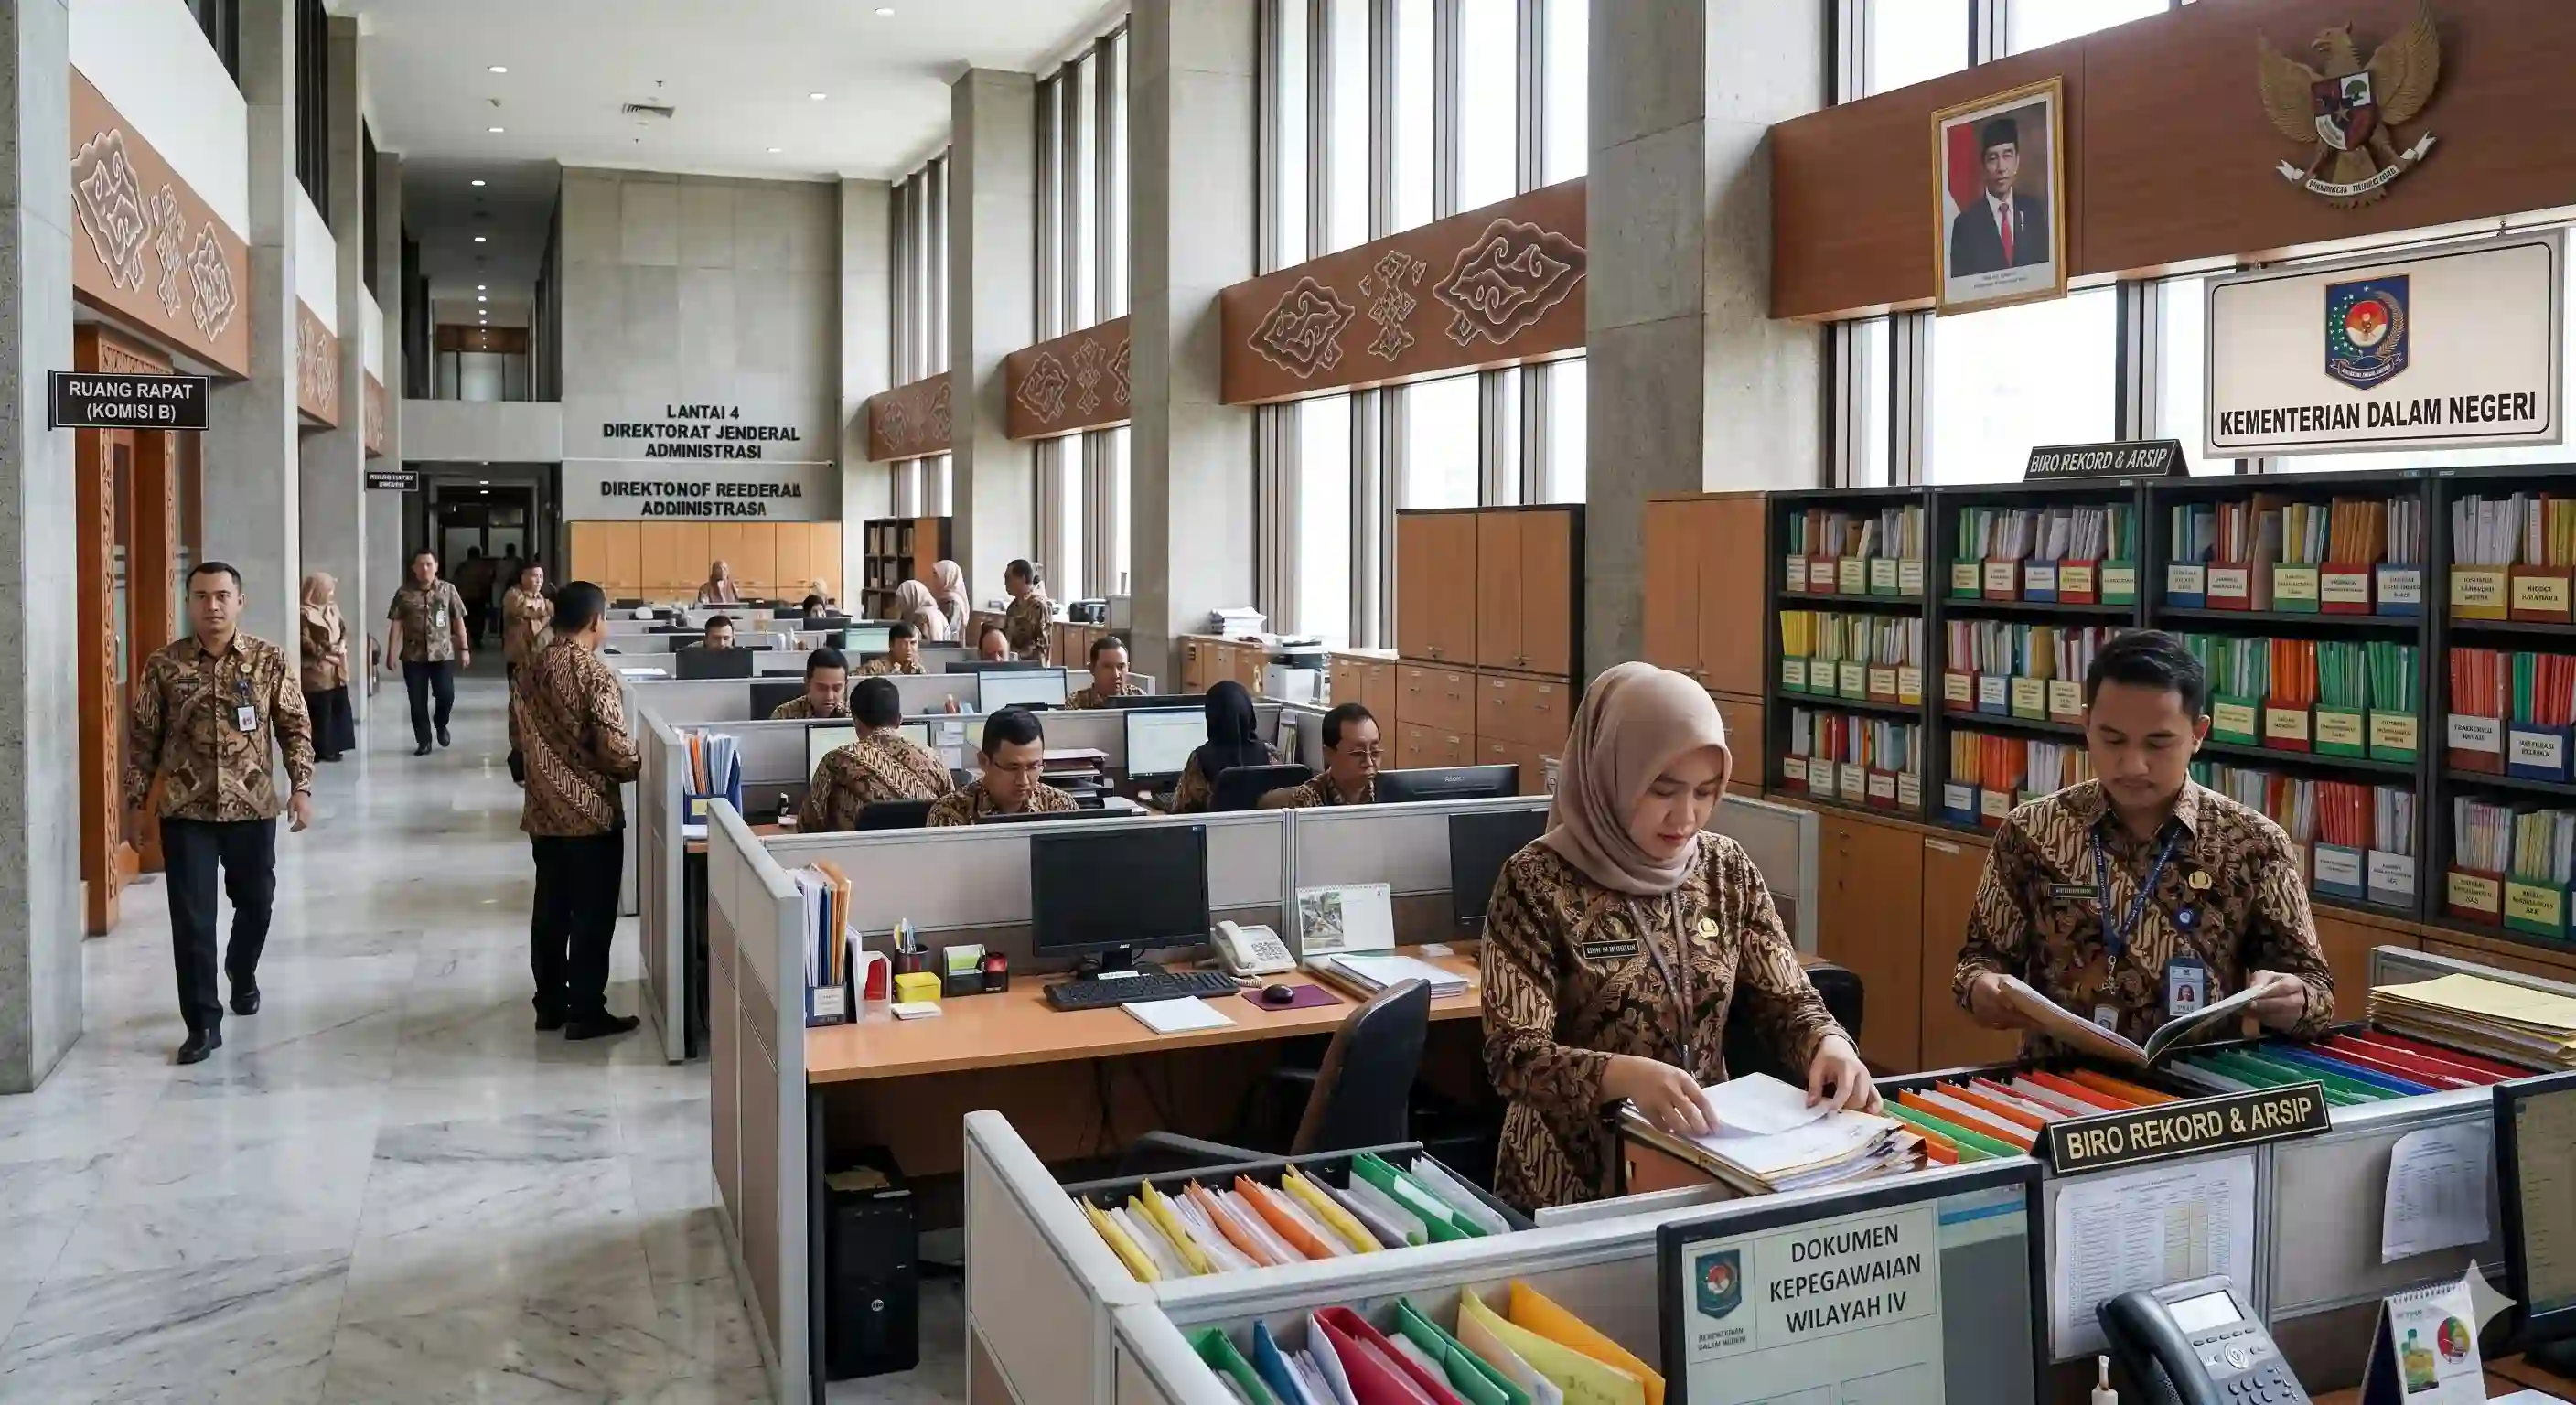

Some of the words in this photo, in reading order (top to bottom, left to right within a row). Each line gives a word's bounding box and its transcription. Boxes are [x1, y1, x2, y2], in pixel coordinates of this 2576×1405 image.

[69, 381, 132, 398] RUANG
[137, 384, 193, 399] RAPAT
[87, 403, 153, 421] (KOMISI
[158, 404, 177, 423] B)
[667, 404, 725, 419] LANTAI
[729, 406, 739, 420] 4
[2220, 403, 2360, 435] KEMENTERIAN
[2367, 398, 2442, 428] DALAM
[2449, 391, 2536, 424] NEGERI
[603, 424, 711, 439] DIREKTORAT
[716, 425, 800, 441] JENDERAL
[645, 444, 761, 458] ADMINISTRASI
[2029, 454, 2060, 473] BIRO
[2060, 451, 2112, 471] REKORD
[2114, 450, 2124, 469] &
[2126, 448, 2167, 468] ARSIP
[2066, 1126, 2124, 1160] BIRO
[2129, 1110, 2224, 1150] REKORD
[2229, 1107, 2246, 1133] &
[2251, 1097, 2312, 1131] ARSIP
[1791, 1224, 1898, 1263] DOKUMEN
[1770, 1253, 1921, 1302] KEPEGAWAIAN
[1786, 1295, 1880, 1333] WILAYAH
[1888, 1291, 1906, 1314] IV
